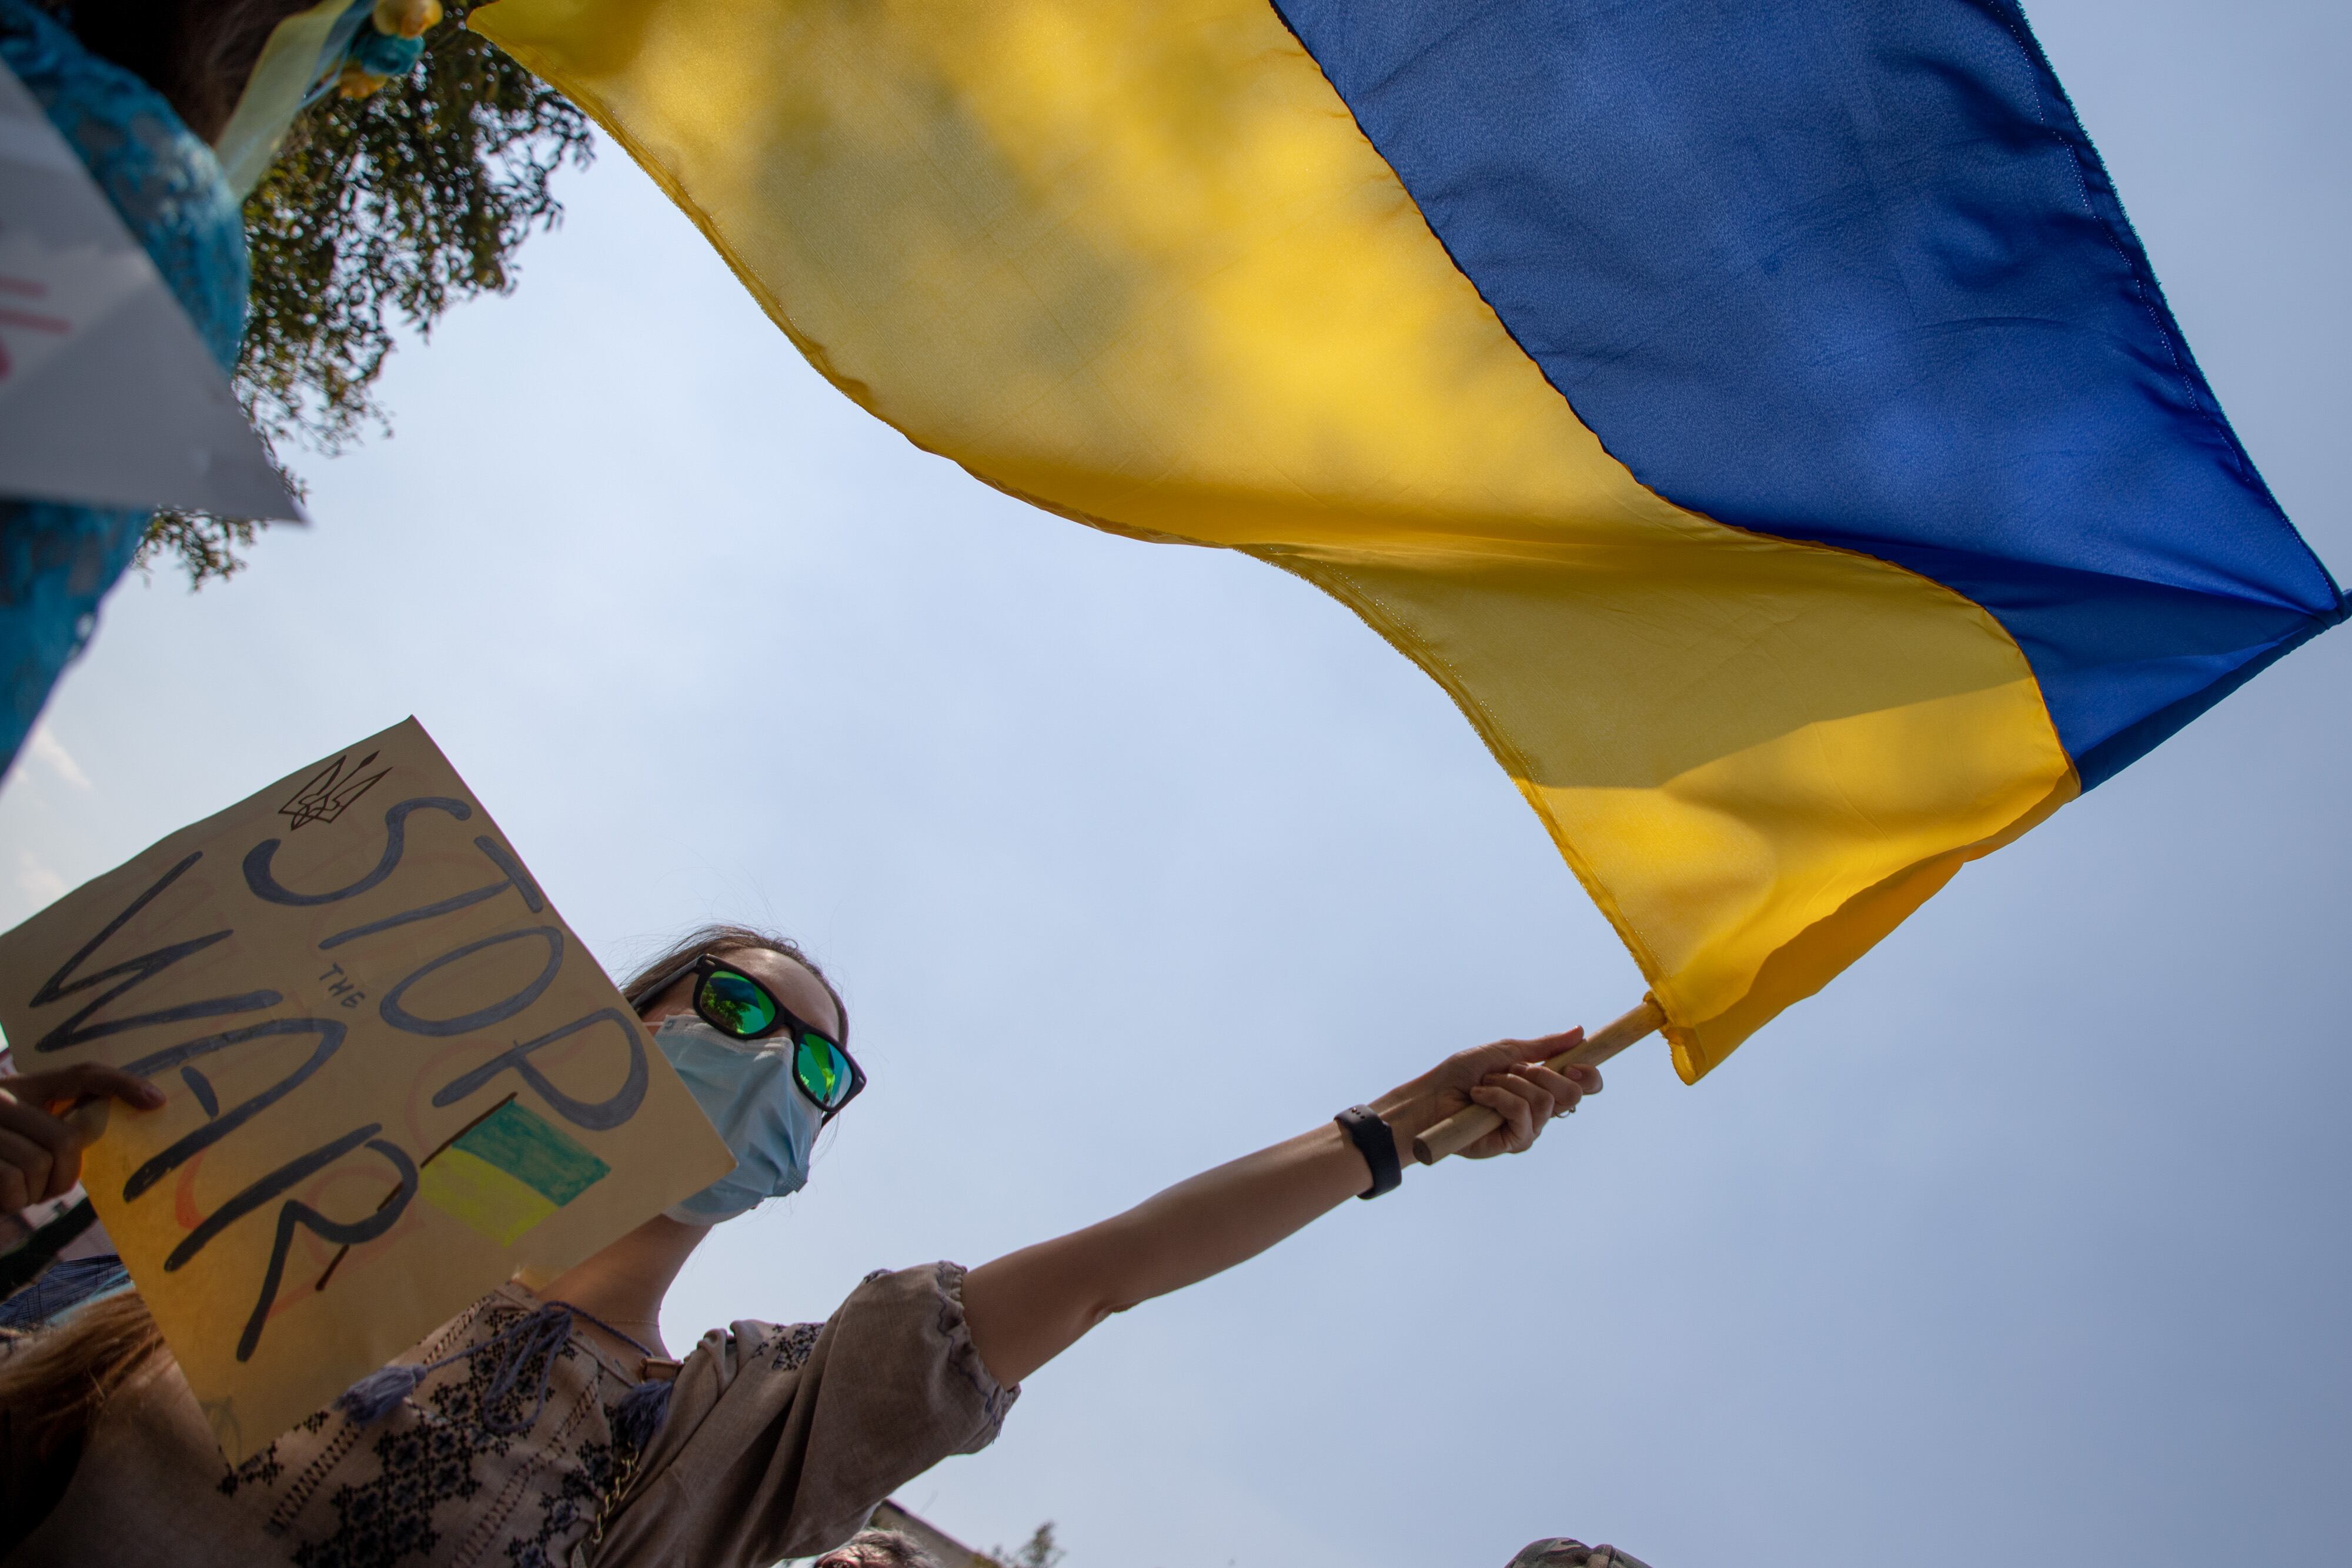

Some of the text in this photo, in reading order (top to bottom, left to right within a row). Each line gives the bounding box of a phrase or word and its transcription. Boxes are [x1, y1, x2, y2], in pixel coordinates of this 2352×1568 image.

[29, 851, 418, 1362] WAR
[242, 797, 649, 1131] STOP
[319, 961, 366, 1009] THE
